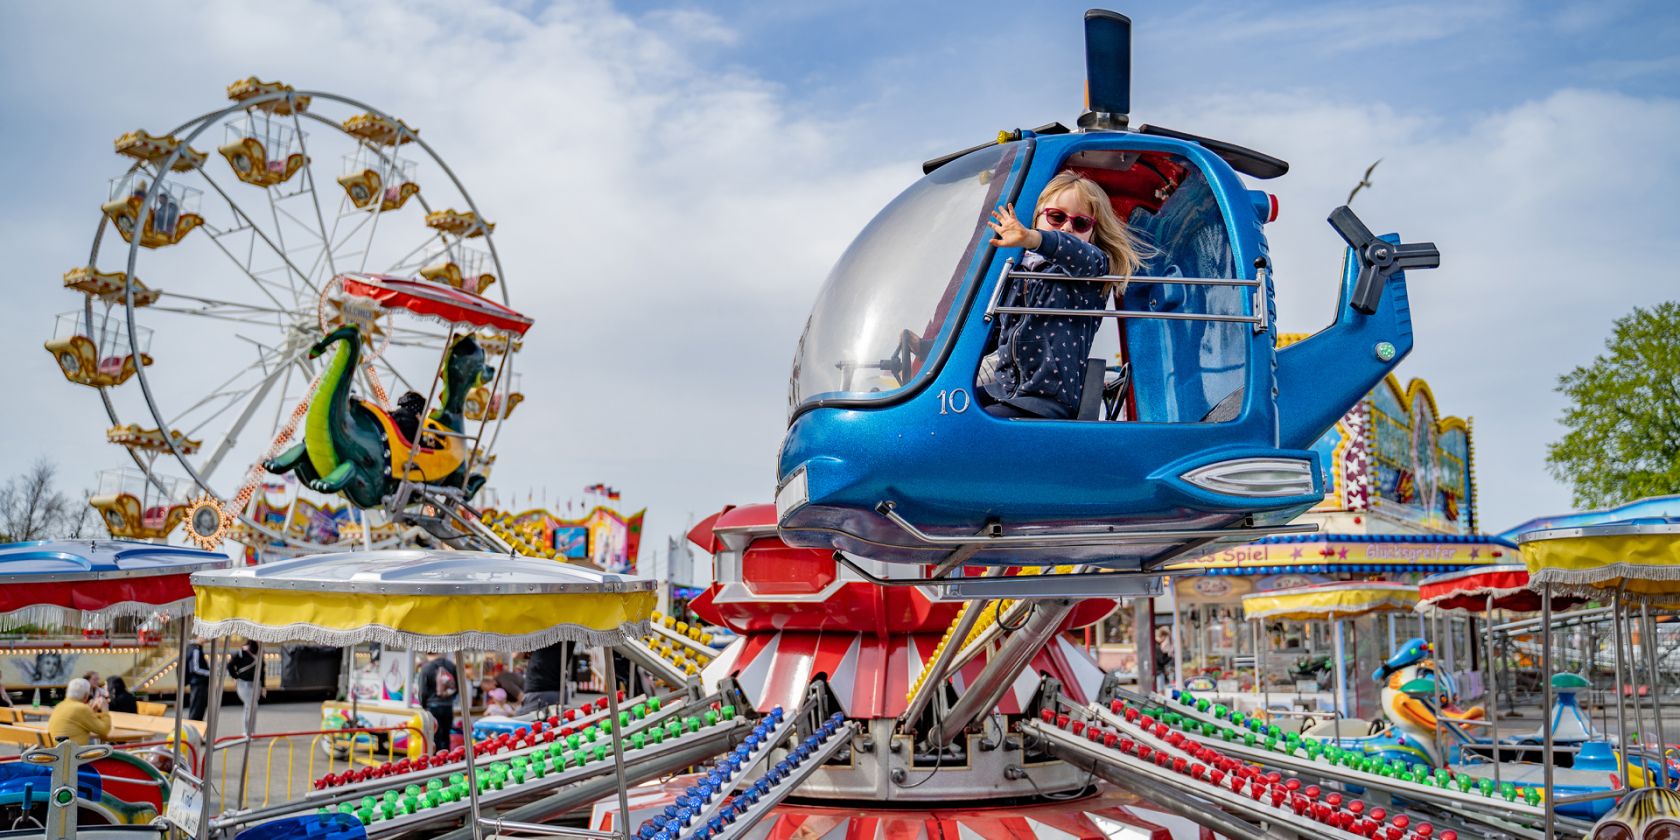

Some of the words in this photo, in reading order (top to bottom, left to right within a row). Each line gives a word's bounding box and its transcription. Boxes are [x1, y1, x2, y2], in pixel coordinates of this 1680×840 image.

[936, 388, 970, 414] 10
[1223, 547, 1268, 566] Spiel
[1366, 543, 1456, 563] Glücksgreifer
